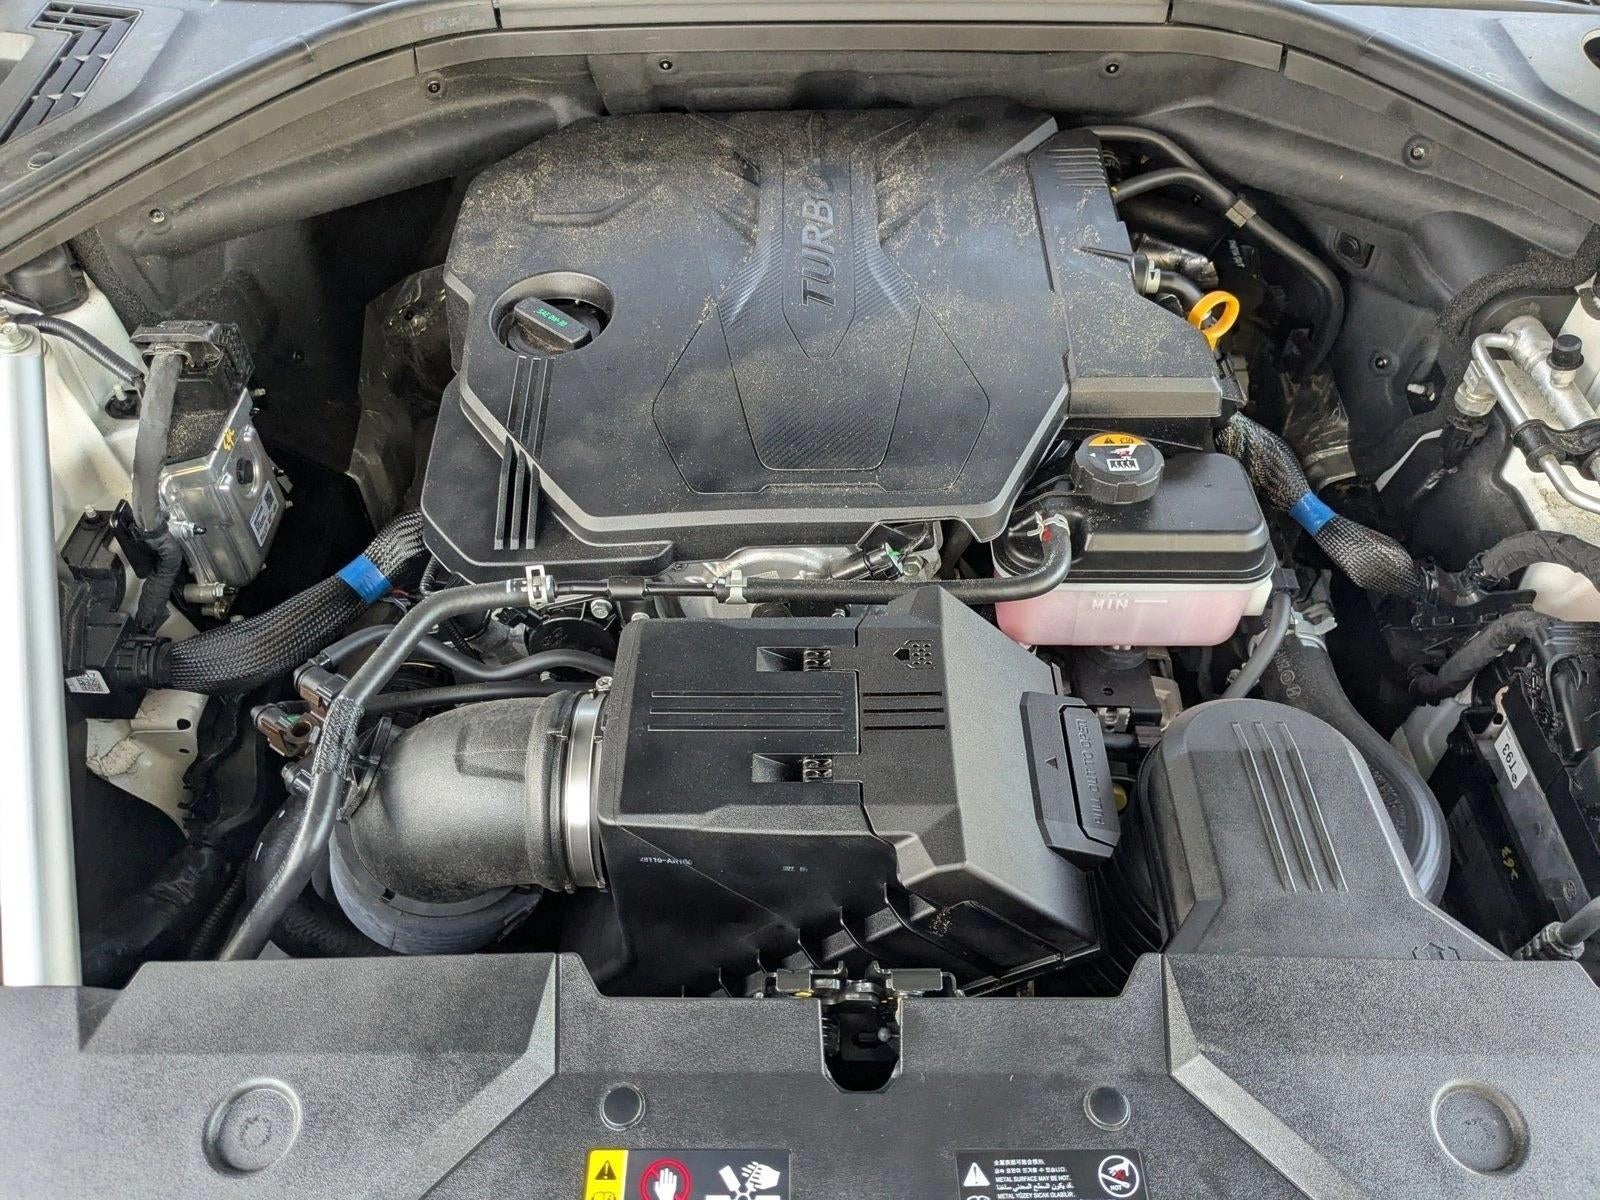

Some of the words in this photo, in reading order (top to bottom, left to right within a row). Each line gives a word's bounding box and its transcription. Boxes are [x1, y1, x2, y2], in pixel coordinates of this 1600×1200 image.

[801, 173, 837, 307] TURBO
[1091, 599, 1129, 610] MIN
[1077, 719, 1091, 748] OPEN
[1082, 751, 1094, 766] TO
[1502, 743, 1517, 773] T93
[1086, 769, 1100, 792] OUT
[1091, 798, 1105, 825] PULL
[1015, 1191, 1033, 1199] YÜZEY
